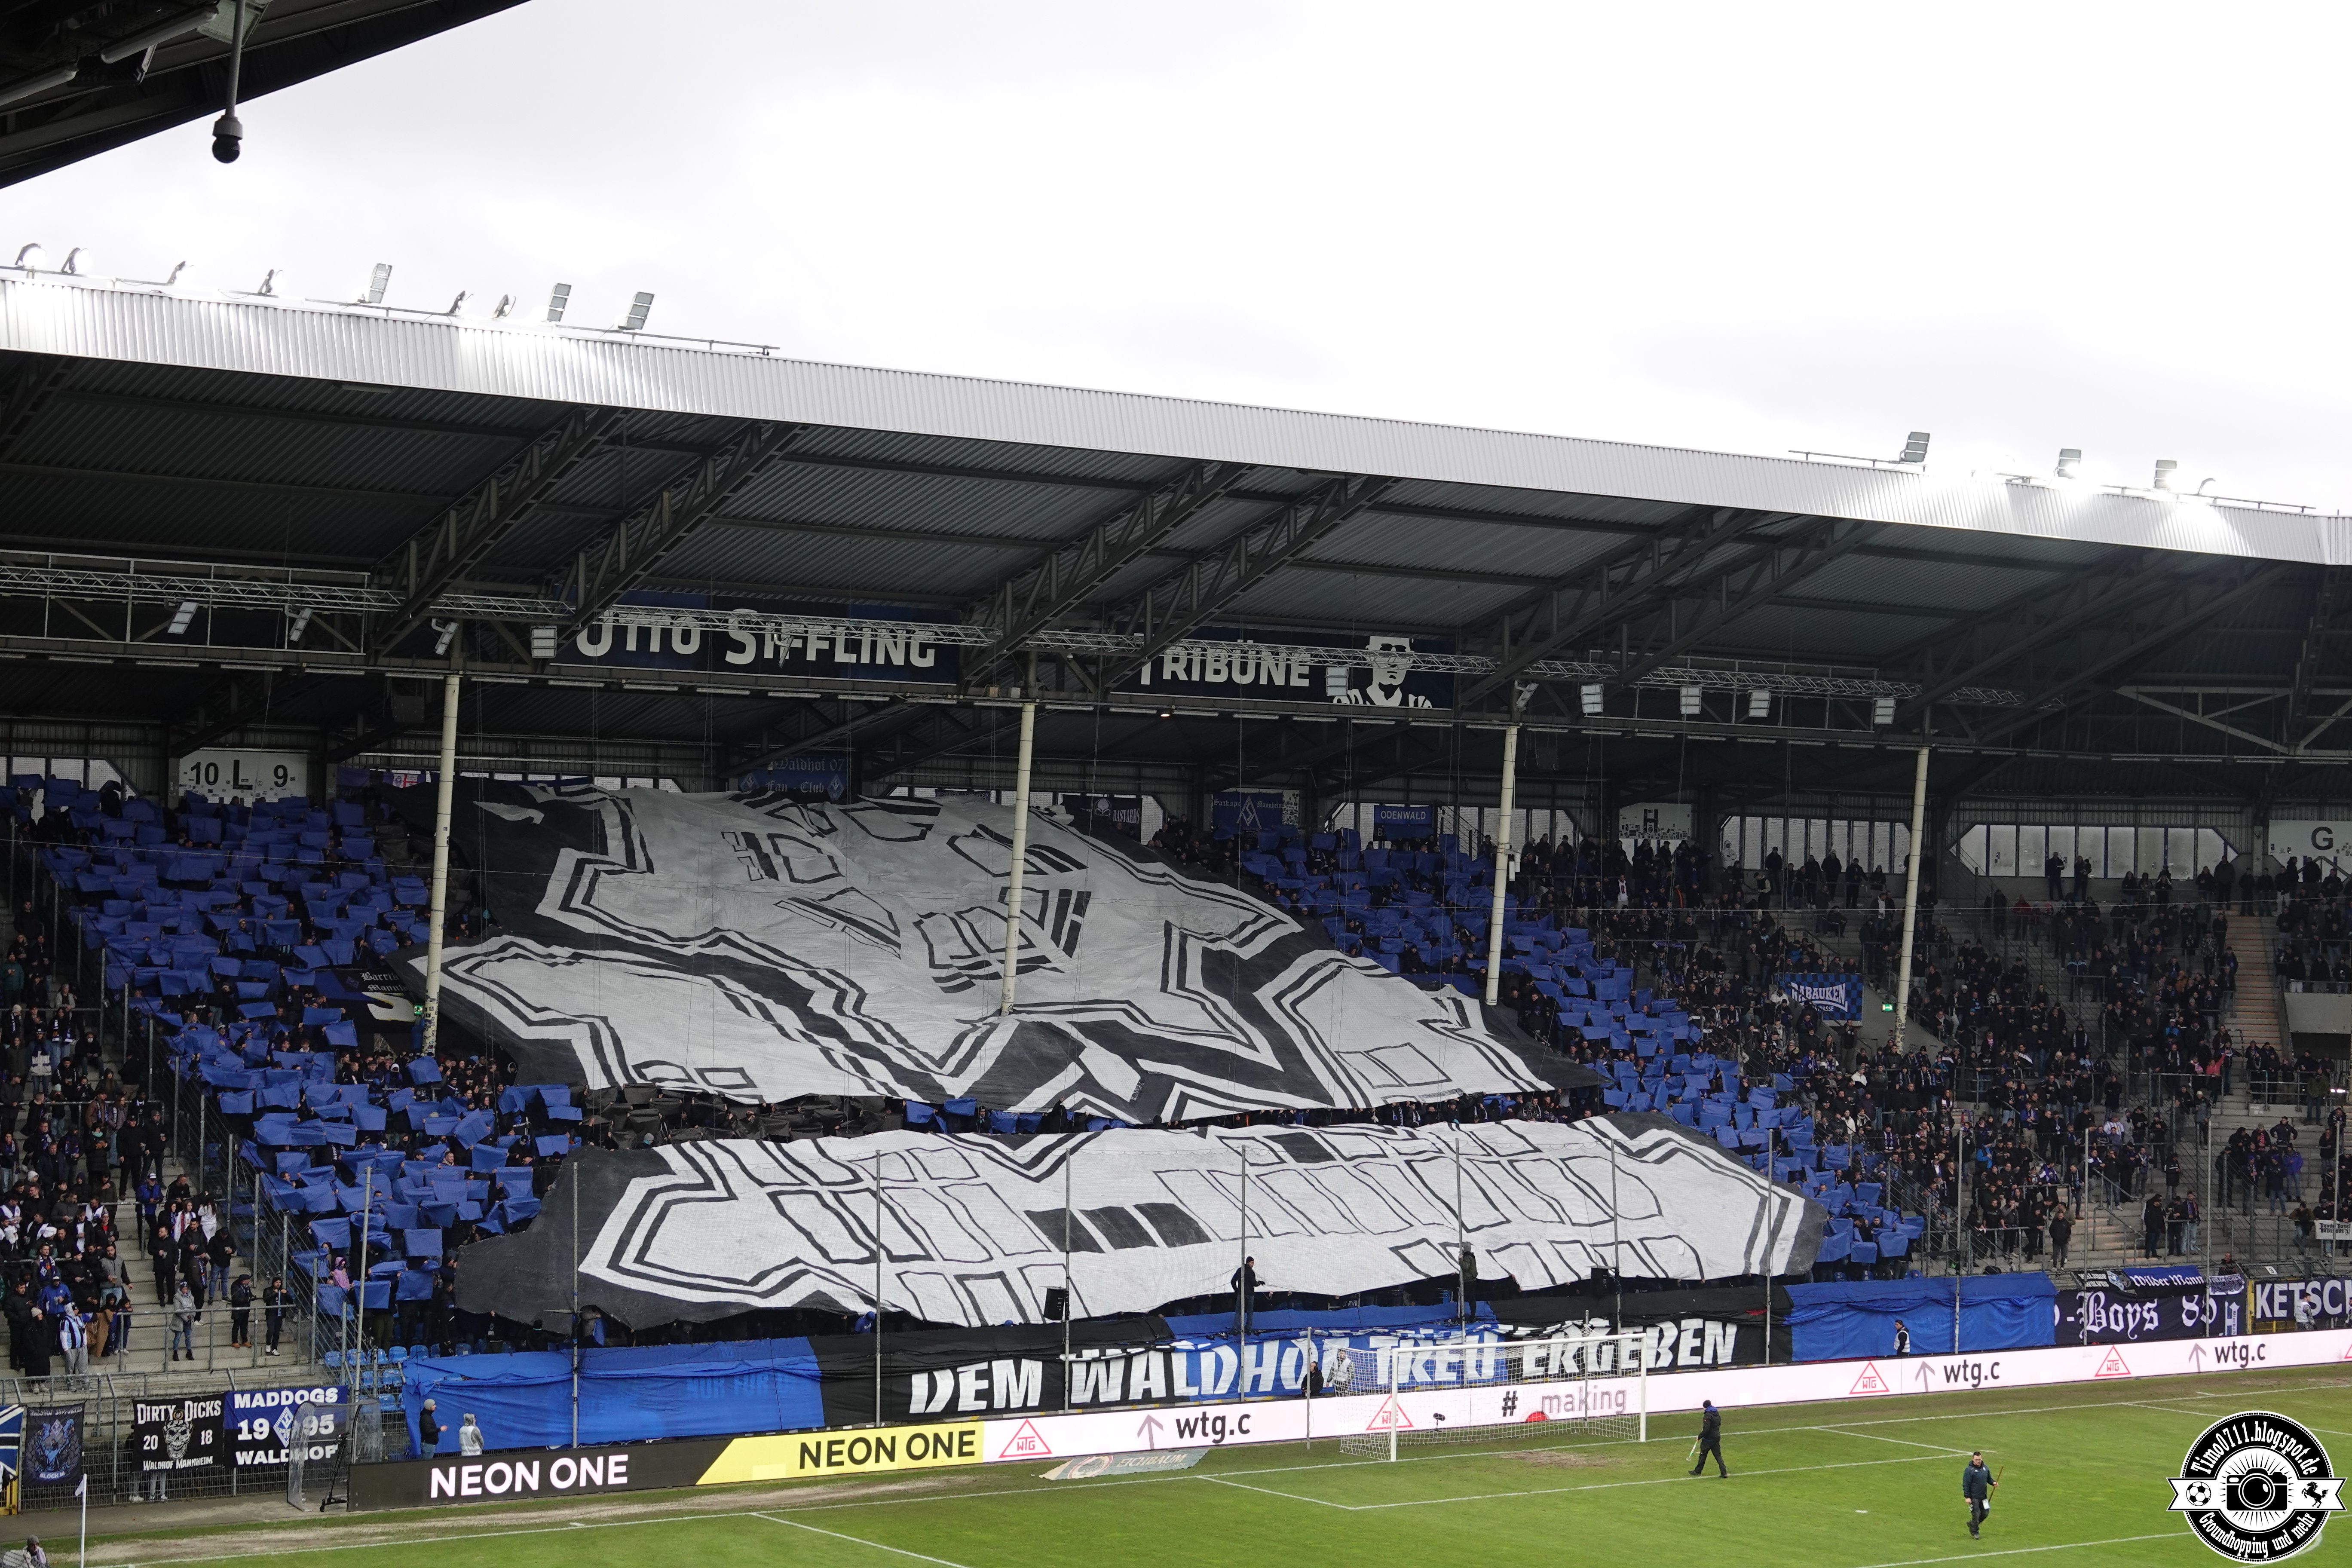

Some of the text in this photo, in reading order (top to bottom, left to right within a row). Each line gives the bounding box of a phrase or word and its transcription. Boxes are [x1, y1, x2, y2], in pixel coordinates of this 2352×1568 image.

[576, 608, 935, 668] OTTO SIFFLING
[190, 759, 288, 790] 10 L 9
[830, 758, 845, 771] 07
[800, 781, 824, 793] Club
[1112, 808, 1140, 824] BASTARDS
[1381, 810, 1426, 820] ODENWALD
[1643, 808, 1658, 833] H
[2311, 826, 2334, 851] G
[1791, 982, 1846, 1005] RABAUKEN
[2129, 1274, 2170, 1287] Wilder
[2173, 1274, 2205, 1286] Mann
[909, 1358, 1043, 1414] DEM
[1369, 1331, 1498, 1384] TREU
[1522, 1318, 1737, 1377] ERGEBEN
[2107, 1359, 2120, 1372] WTG
[2214, 1341, 2266, 1369] wtg.c
[1862, 1376, 1877, 1389] WTG
[1943, 1358, 2000, 1388] wtg.c
[234, 1387, 339, 1409] MADDOGS
[1541, 1385, 1627, 1415] making
[137, 1400, 222, 1425] DIRTY DICKS
[237, 1414, 334, 1440] 19 95
[1176, 1411, 1252, 1444] wtg.c
[143, 1429, 213, 1450] 20 18
[799, 1430, 976, 1470] NEON ONE
[1017, 1436, 1035, 1452] WTG
[143, 1455, 214, 1471] WALDHOF MANNHEIM
[1116, 1453, 1188, 1467] EICHBAUM
[430, 1454, 629, 1499] NEON ONE
